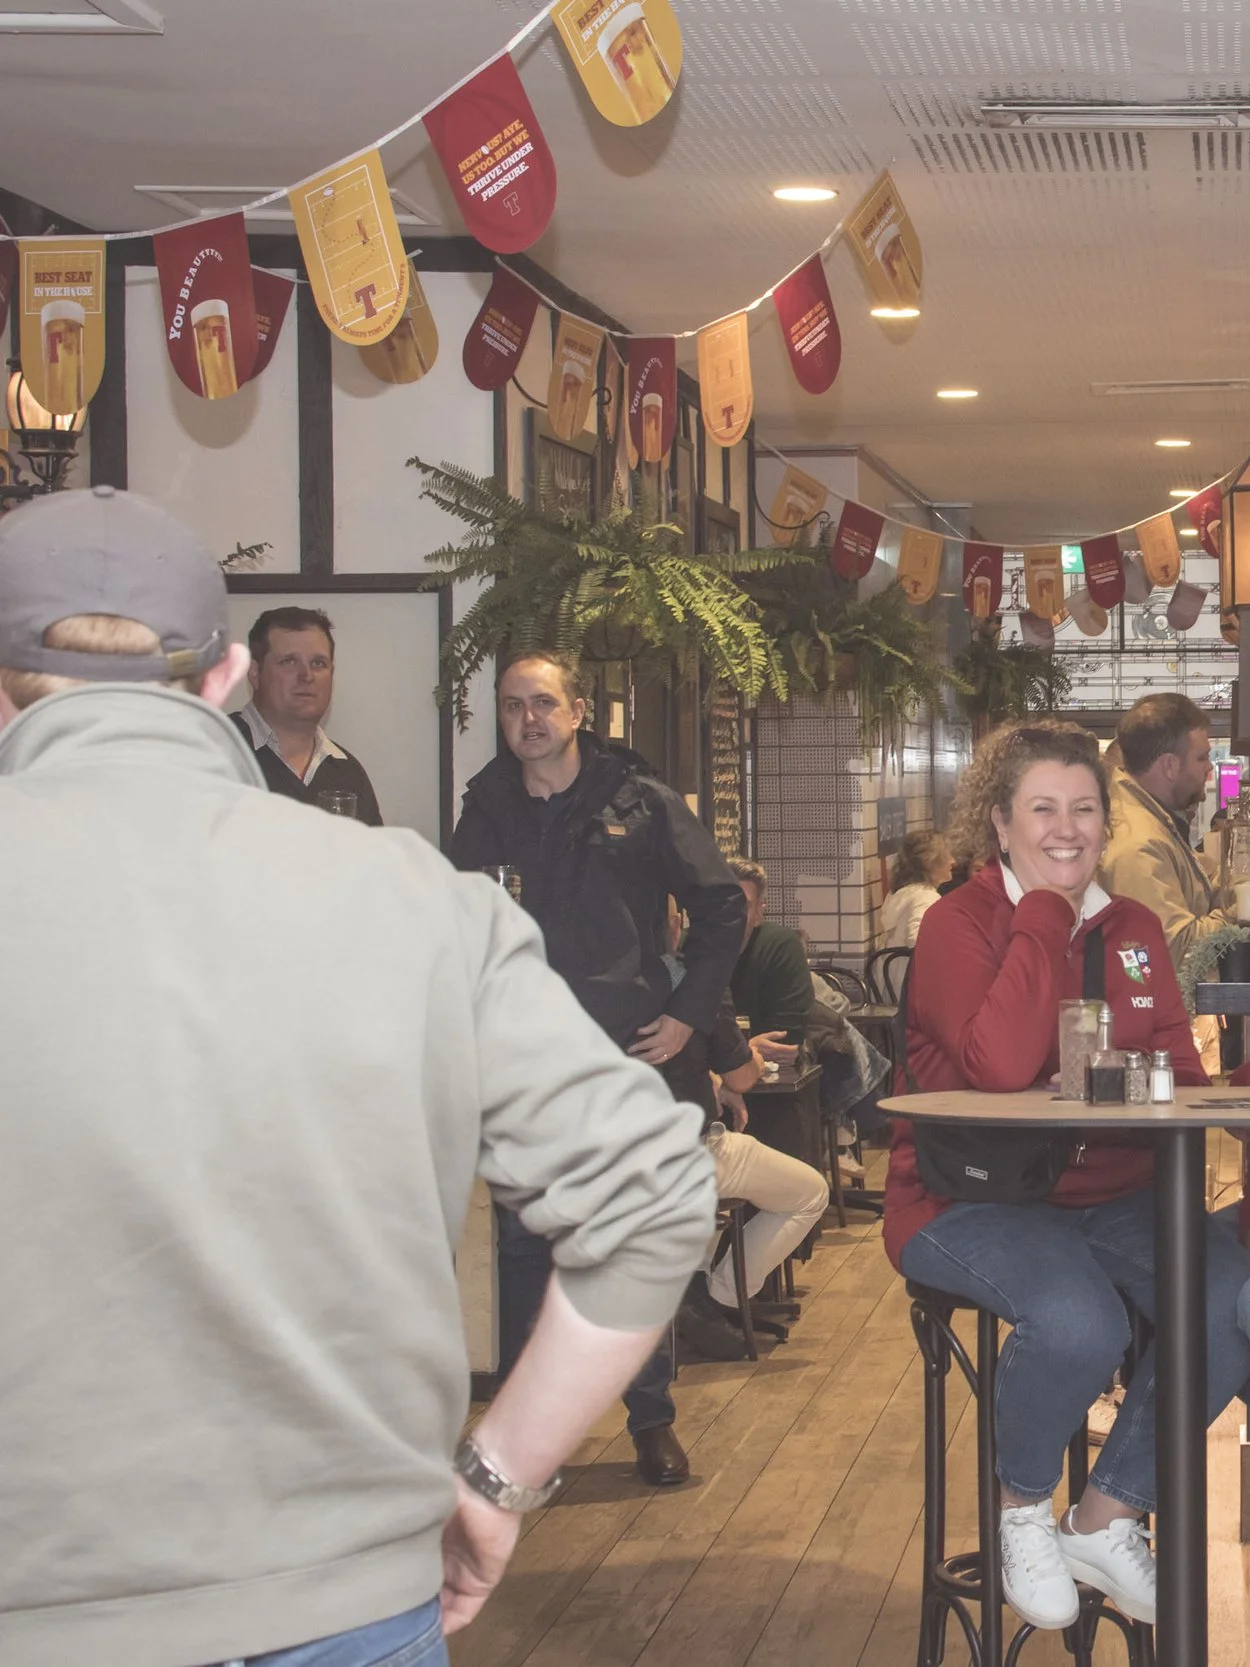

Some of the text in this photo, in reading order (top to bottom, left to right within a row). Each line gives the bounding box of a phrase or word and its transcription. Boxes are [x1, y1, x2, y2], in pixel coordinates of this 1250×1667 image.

[461, 169, 476, 185] US
[494, 140, 514, 161] BUT
[512, 129, 530, 147] WE
[467, 142, 534, 196] THRIVE UNDER
[34, 271, 93, 283] BEST SEAT
[34, 287, 43, 297] IN
[45, 287, 62, 297] THE
[354, 283, 377, 319] T
[169, 303, 186, 340] YOU
[629, 391, 640, 415] YOU
[722, 405, 734, 429] T
